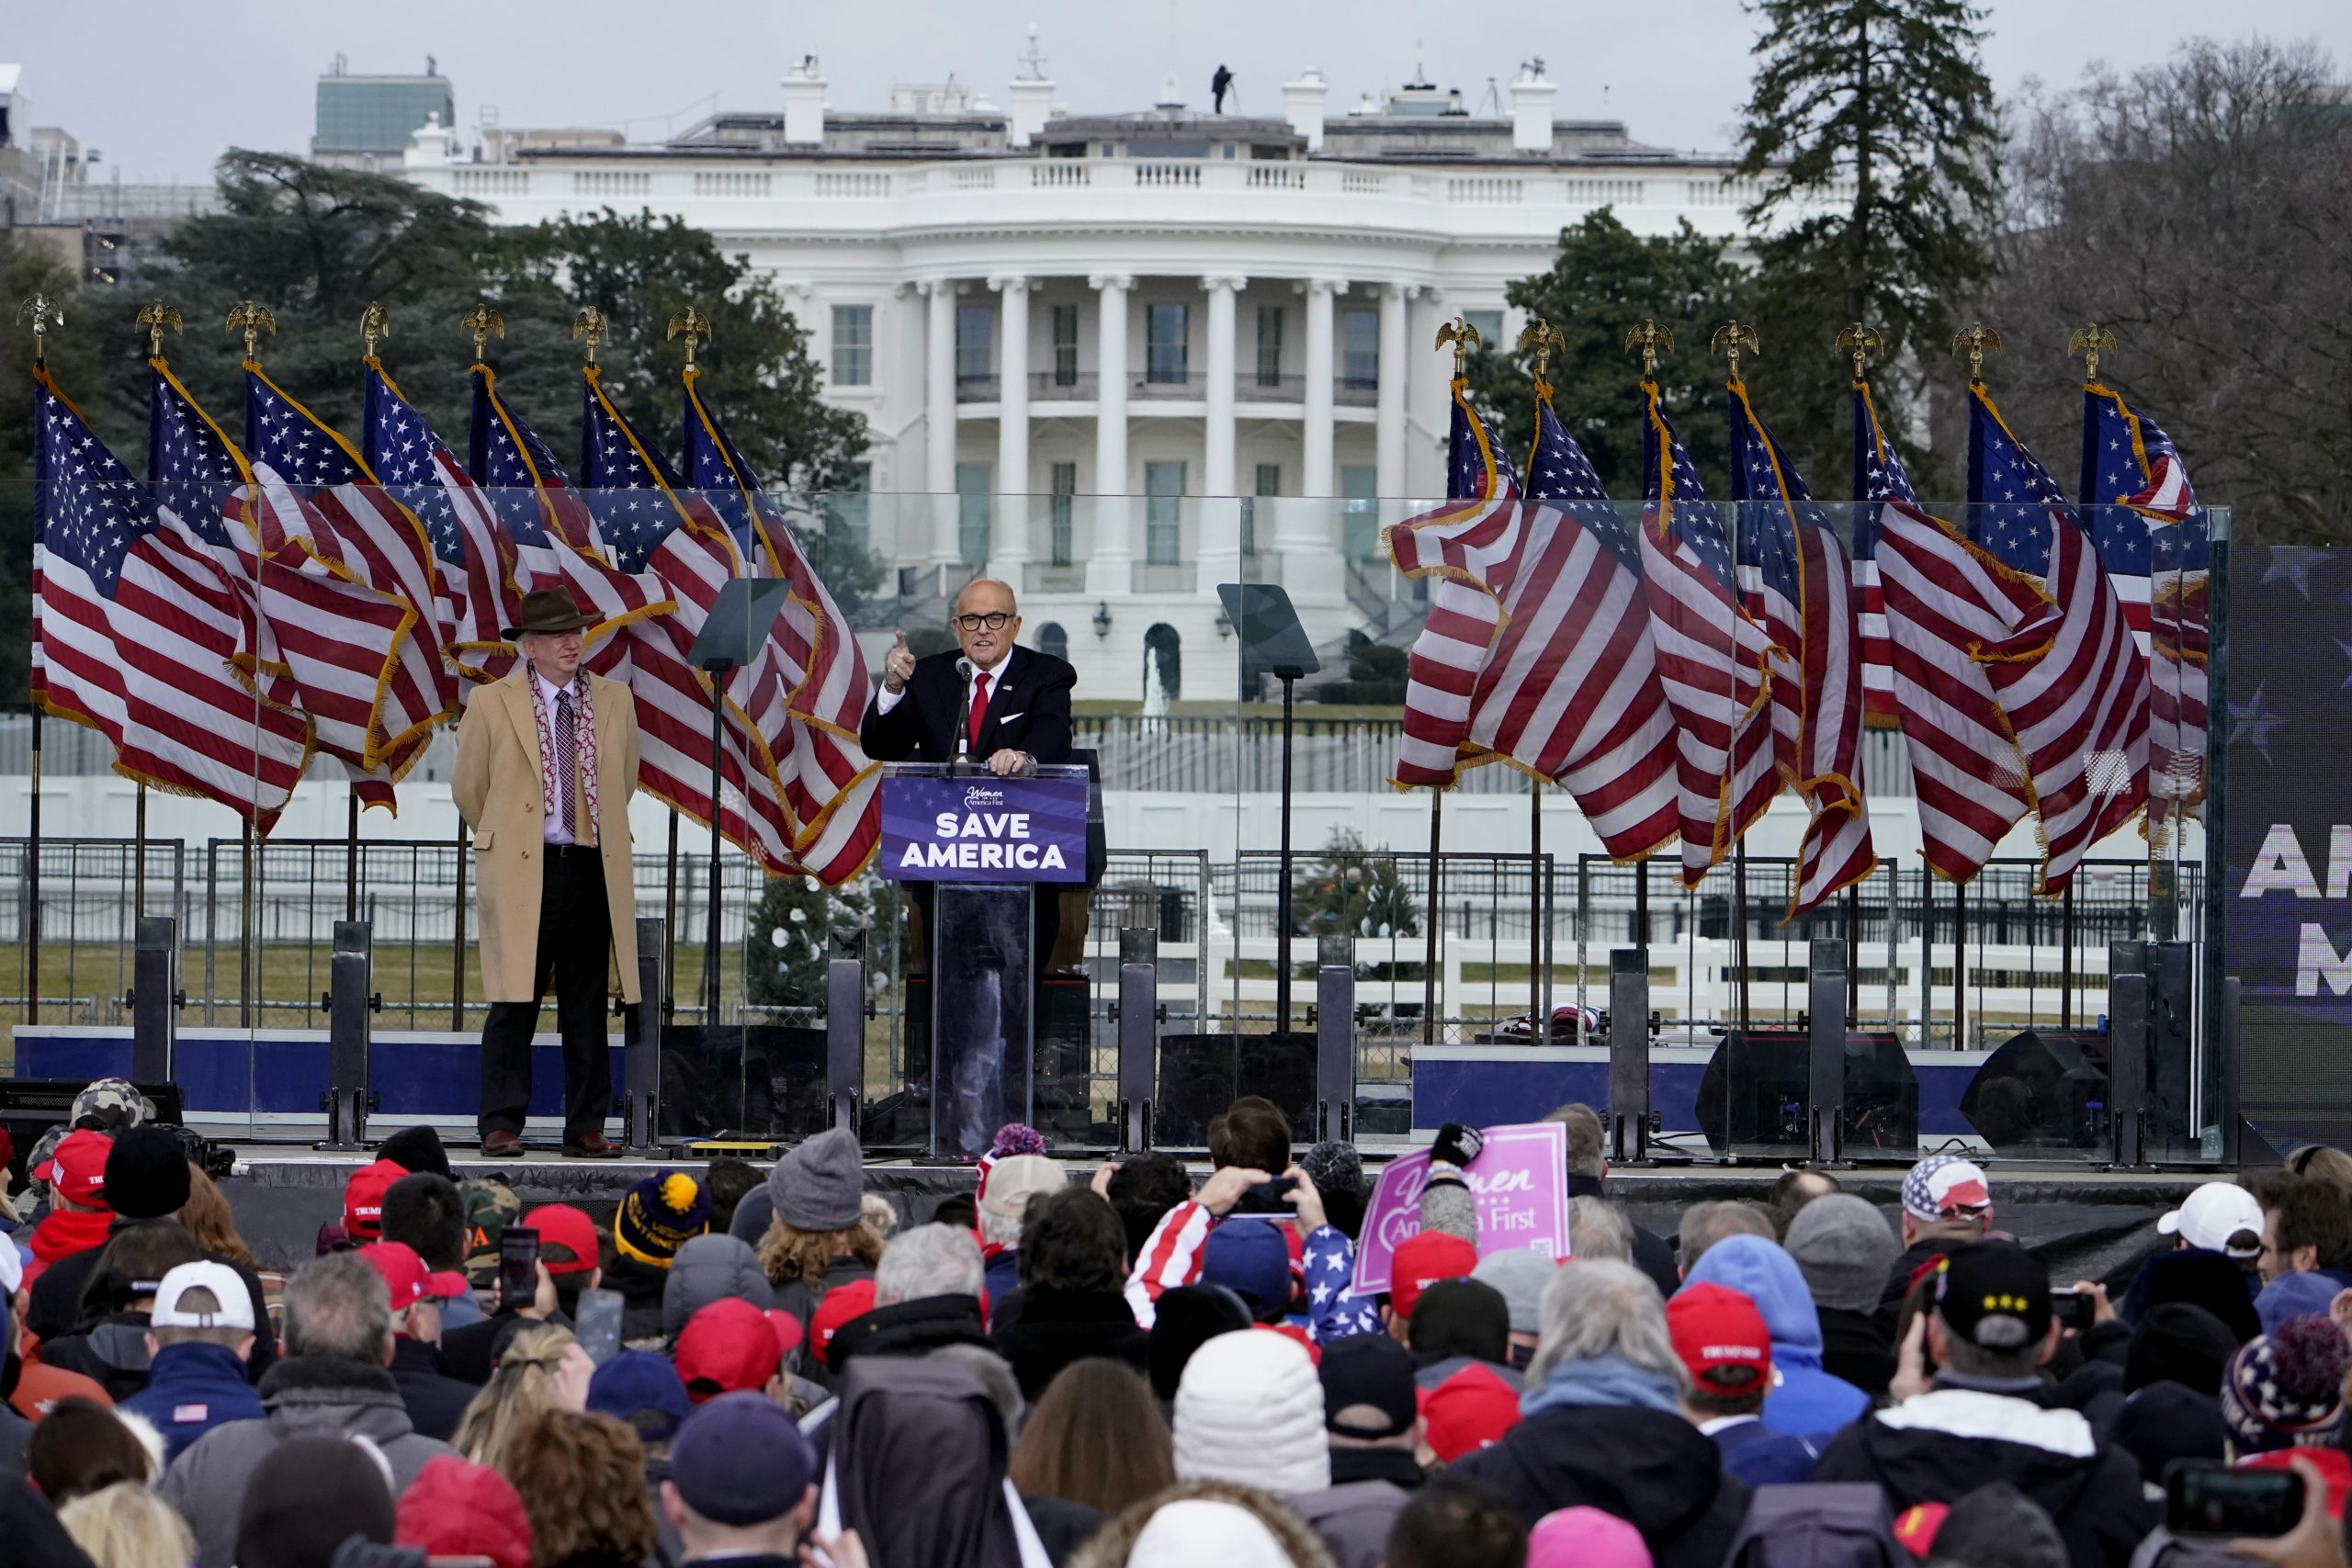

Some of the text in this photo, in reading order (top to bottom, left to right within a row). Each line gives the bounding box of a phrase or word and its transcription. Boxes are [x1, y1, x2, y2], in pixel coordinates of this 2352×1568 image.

[967, 785, 1003, 797] Women
[935, 812, 1030, 839] SAVE
[899, 842, 1067, 869] AMERICA
[1490, 1206, 1537, 1232] First
